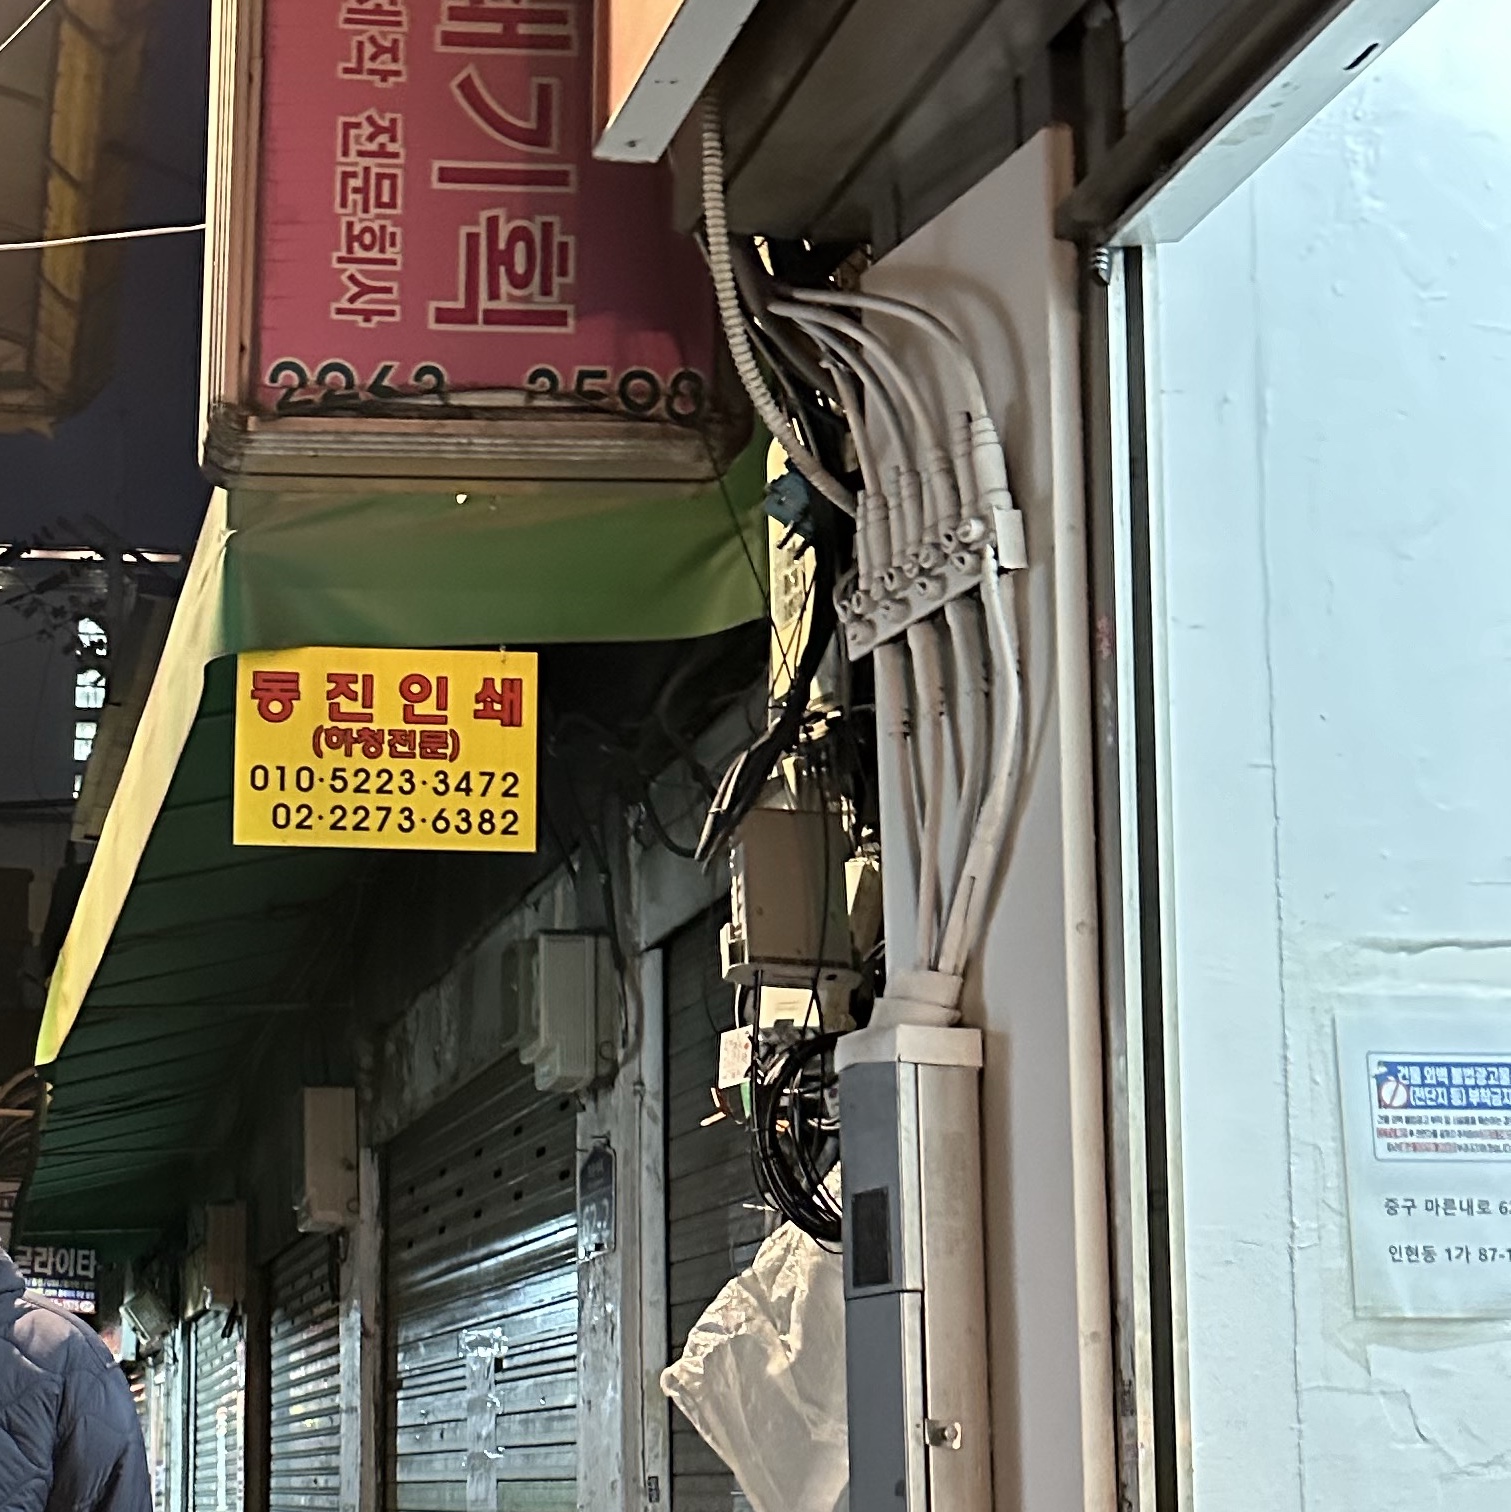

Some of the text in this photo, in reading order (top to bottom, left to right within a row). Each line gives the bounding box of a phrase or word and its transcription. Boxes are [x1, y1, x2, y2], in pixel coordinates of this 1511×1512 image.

[331, 107, 406, 328] 전문회사
[312, 725, 461, 763] (하청전문)
[1384, 1198, 1511, 1217] 중구 마른내로 6
[1388, 1244, 1437, 1264] 인현동
[1444, 1247, 1472, 1264] 1가
